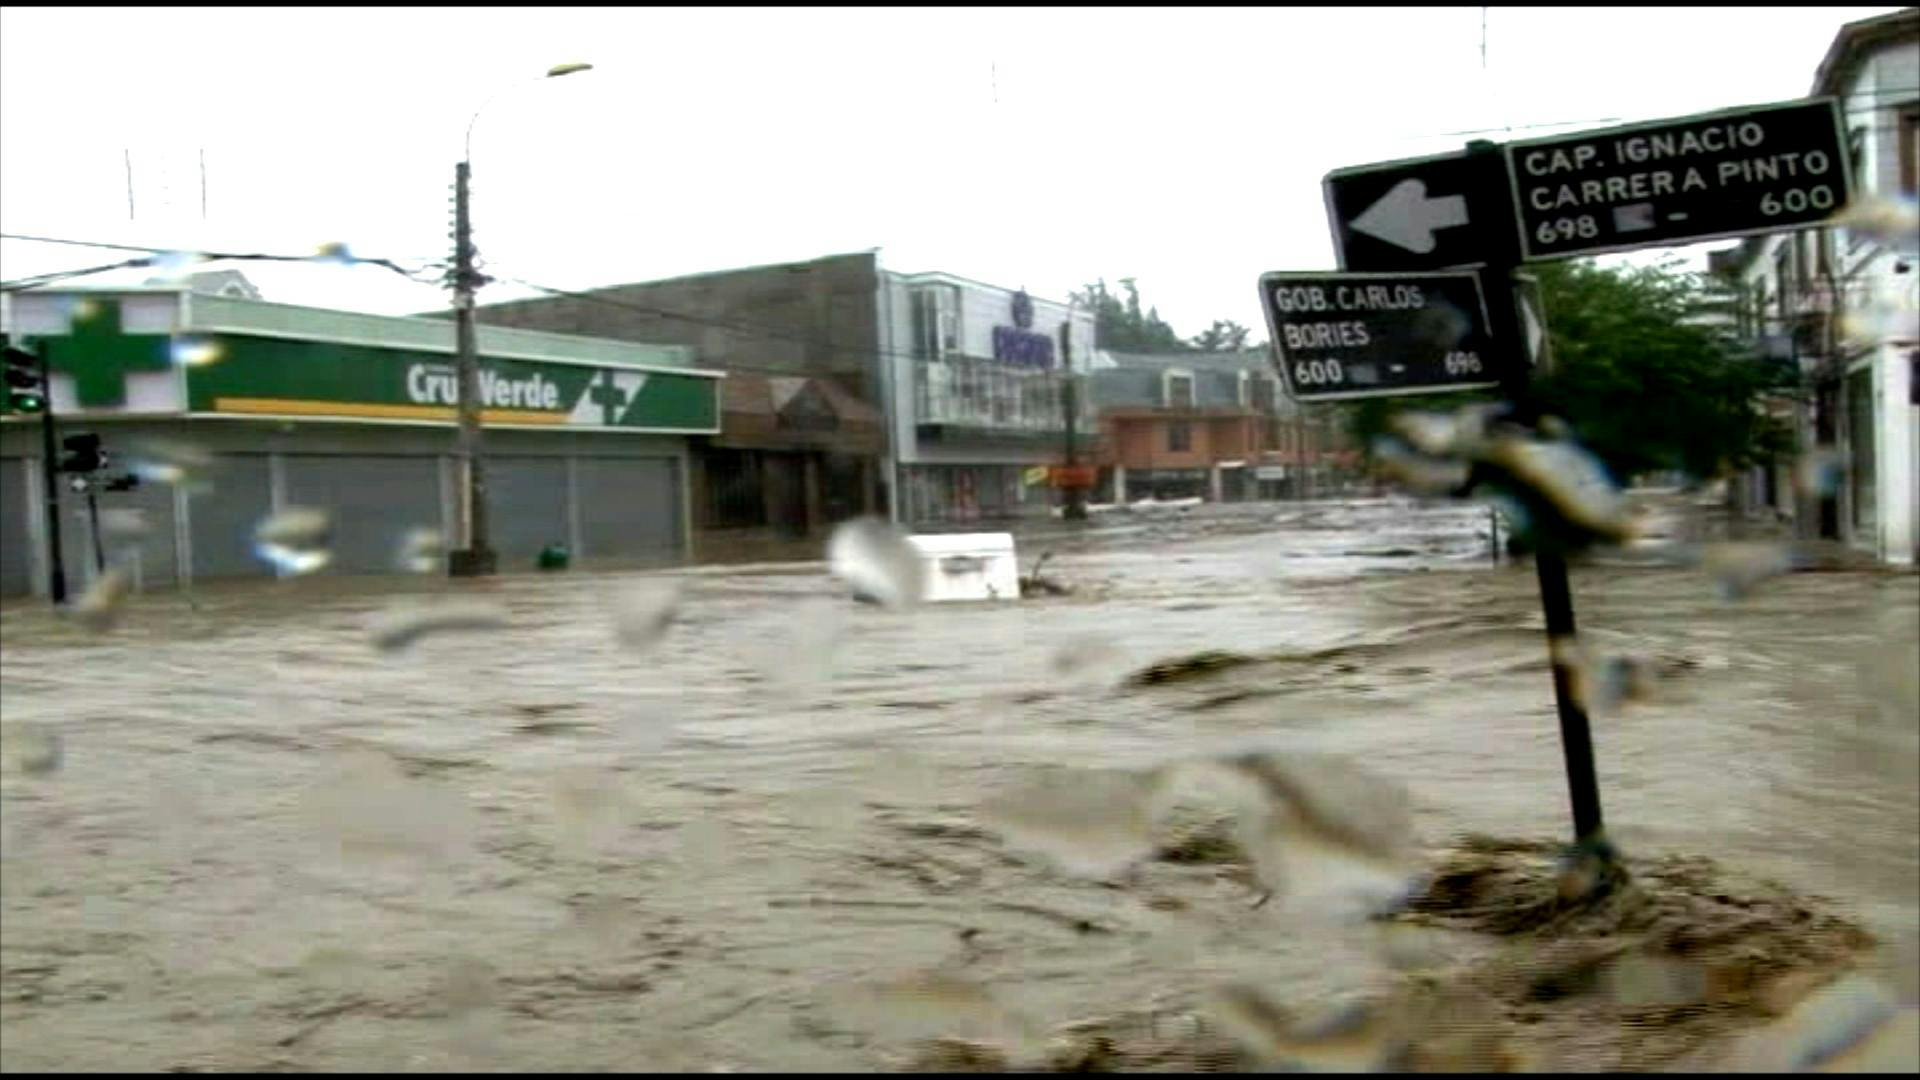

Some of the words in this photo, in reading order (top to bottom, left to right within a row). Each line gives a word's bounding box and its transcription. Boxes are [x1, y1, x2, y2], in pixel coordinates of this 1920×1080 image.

[1525, 145, 1604, 176] CAP.
[1615, 122, 1764, 164] IGNACIO
[1530, 168, 1706, 211] CARRERA
[1718, 150, 1829, 186] PINTO
[1536, 214, 1599, 244] 698
[1759, 185, 1834, 216] 600
[1276, 286, 1336, 312] GOB.
[1337, 286, 1425, 309] CARLOS
[1283, 321, 1370, 348] BORIES
[407, 363, 460, 405] Cru
[478, 369, 558, 409] Verde
[1295, 358, 1342, 384] 600
